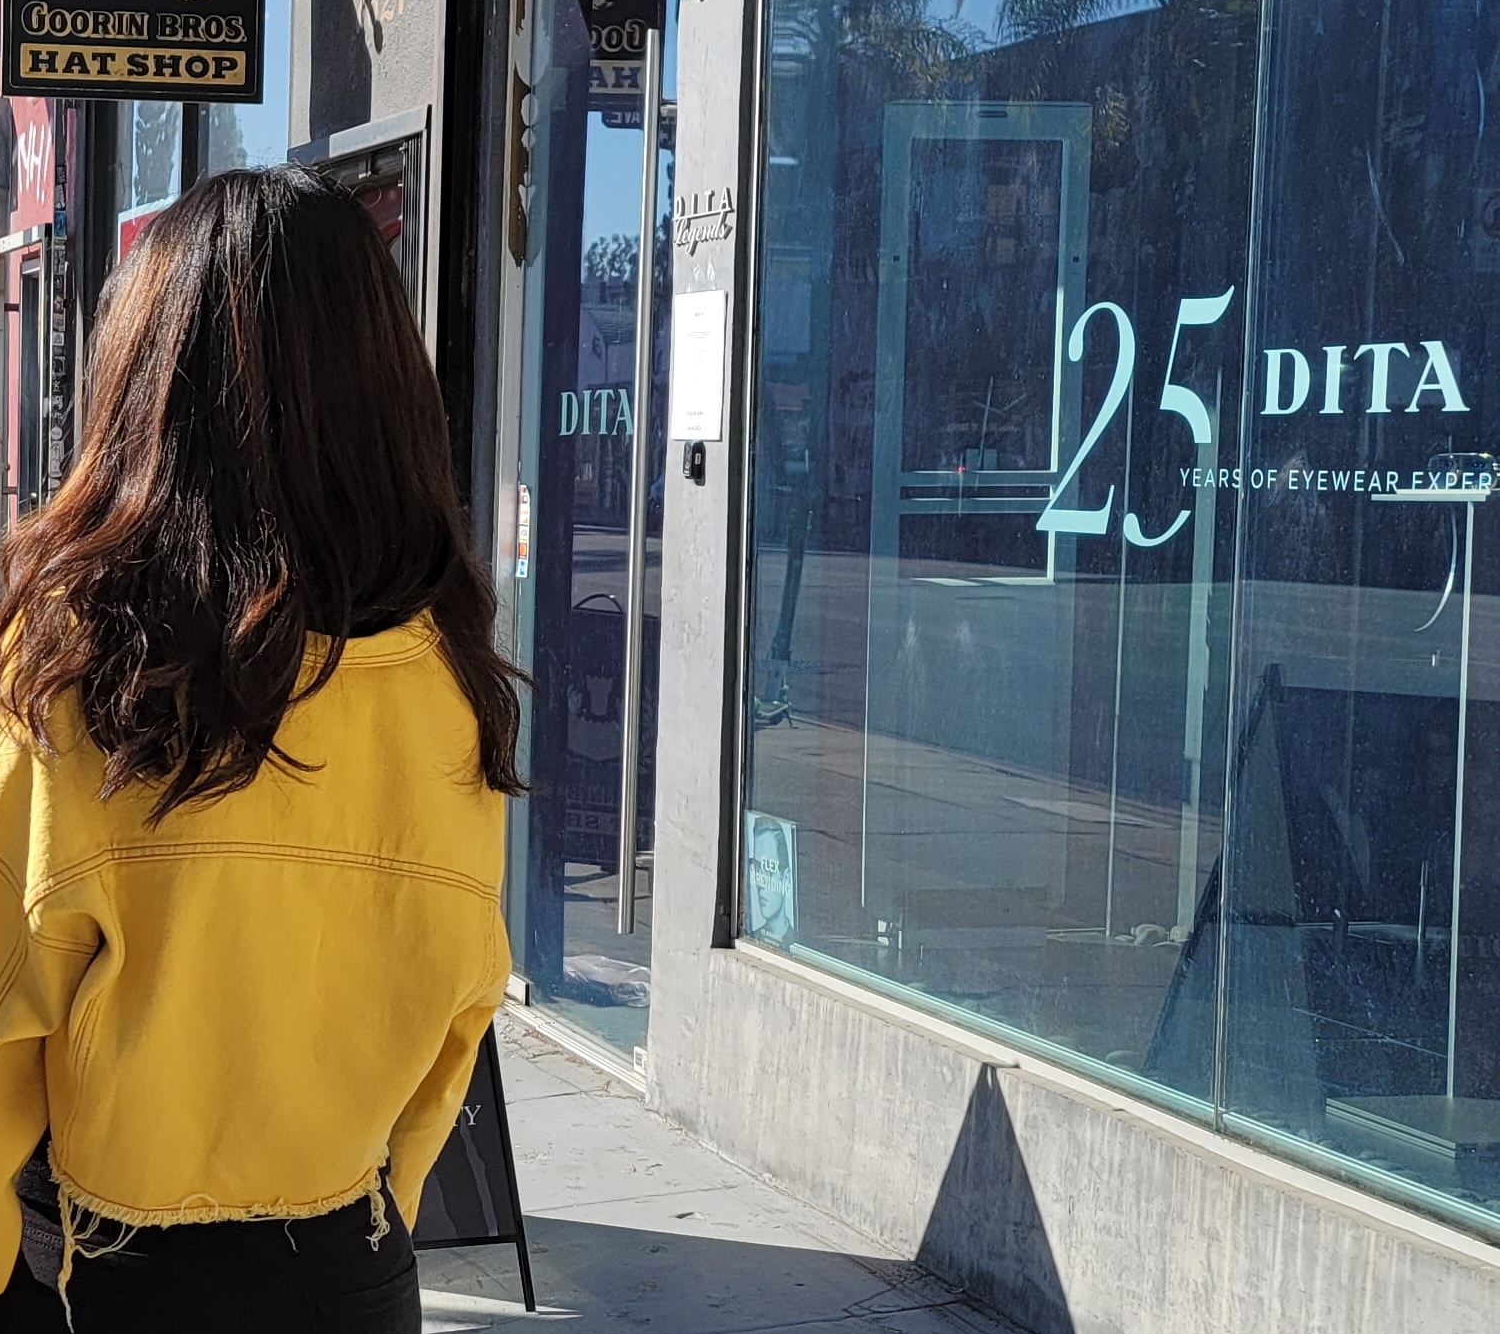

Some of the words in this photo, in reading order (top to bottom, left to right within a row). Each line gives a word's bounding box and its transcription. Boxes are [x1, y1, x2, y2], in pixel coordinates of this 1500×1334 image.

[20, 0, 148, 42] GOORIN
[29, 50, 116, 75] HAT
[127, 53, 239, 79] SHOP
[674, 187, 732, 217] DITA
[674, 217, 730, 253] Legends
[559, 388, 634, 436] DITA
[1036, 285, 1235, 547] 25
[1260, 340, 1471, 415] DITA
[1179, 467, 1242, 488] YEARS
[1250, 468, 1278, 488] OF
[1288, 468, 1399, 492] EYEWEAR
[760, 856, 780, 874] FLEX
